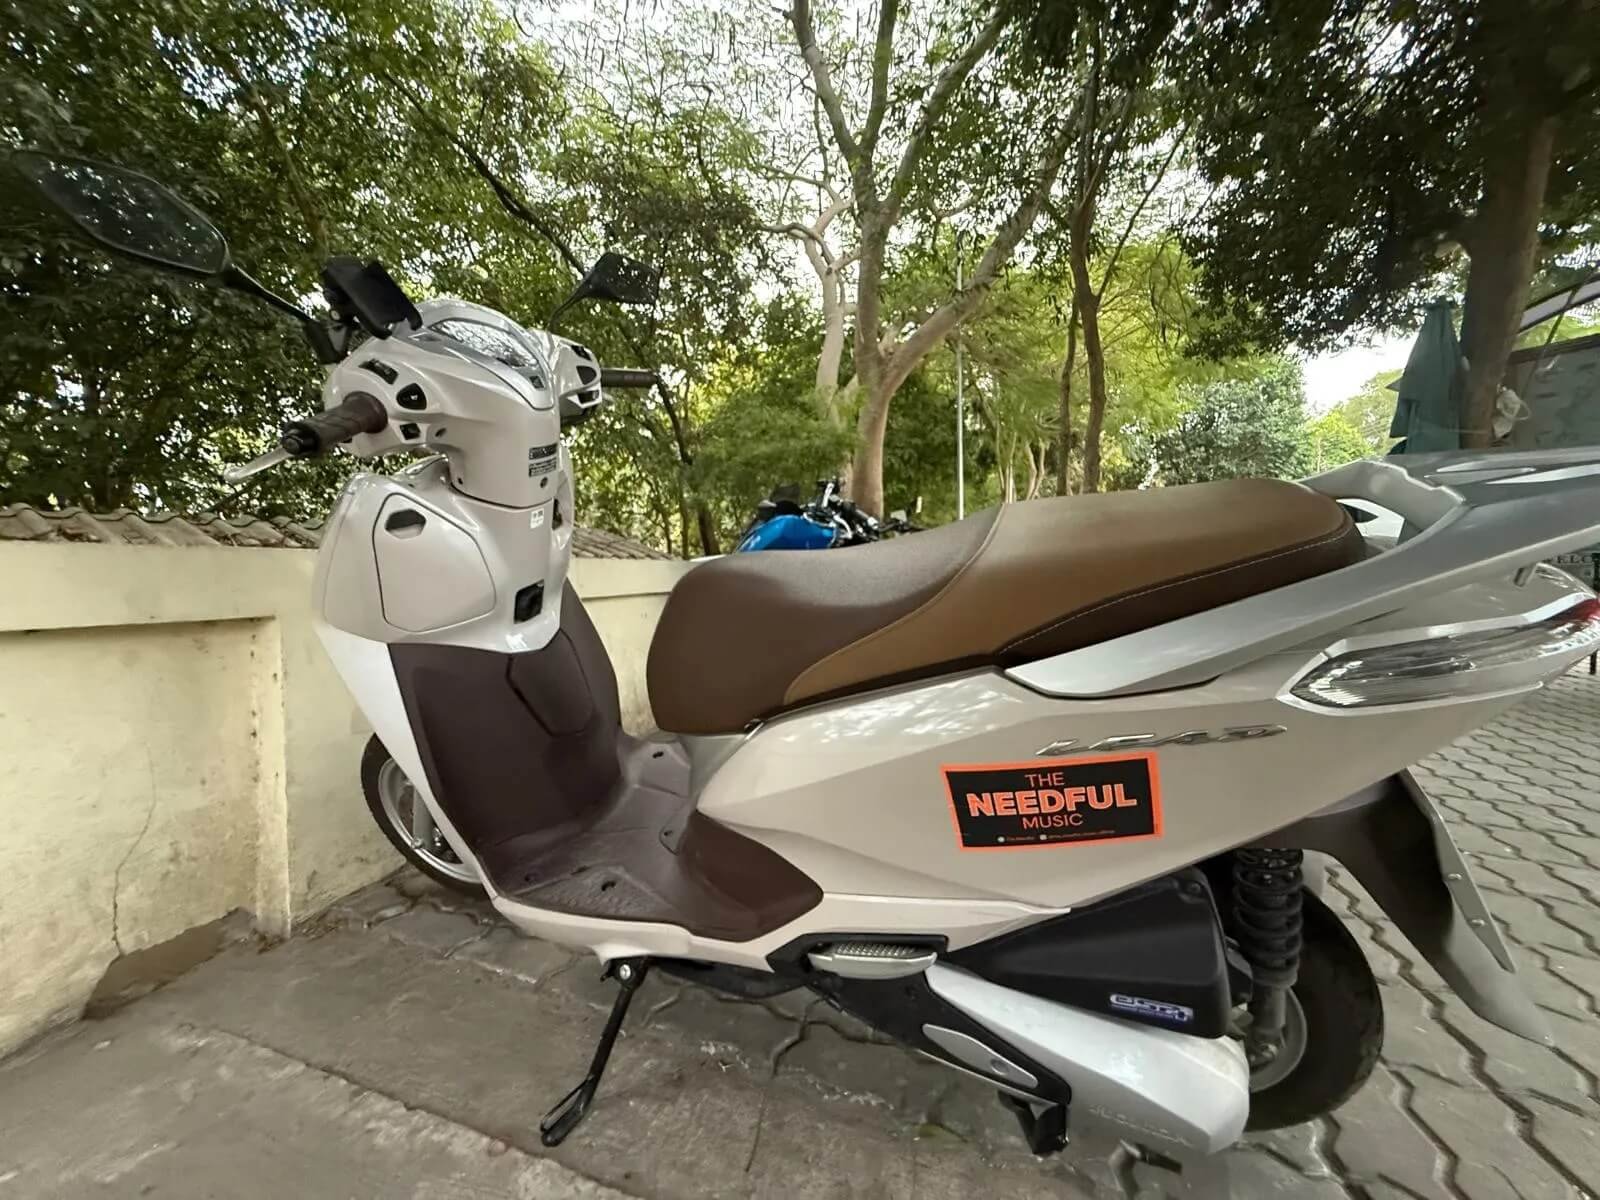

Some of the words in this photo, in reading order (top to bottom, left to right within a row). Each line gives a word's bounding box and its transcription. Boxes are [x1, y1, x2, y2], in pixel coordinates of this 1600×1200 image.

[1025, 772, 1065, 788] THE
[966, 783, 1137, 817] NEEDFUL
[1022, 813, 1083, 829] MUSIC
